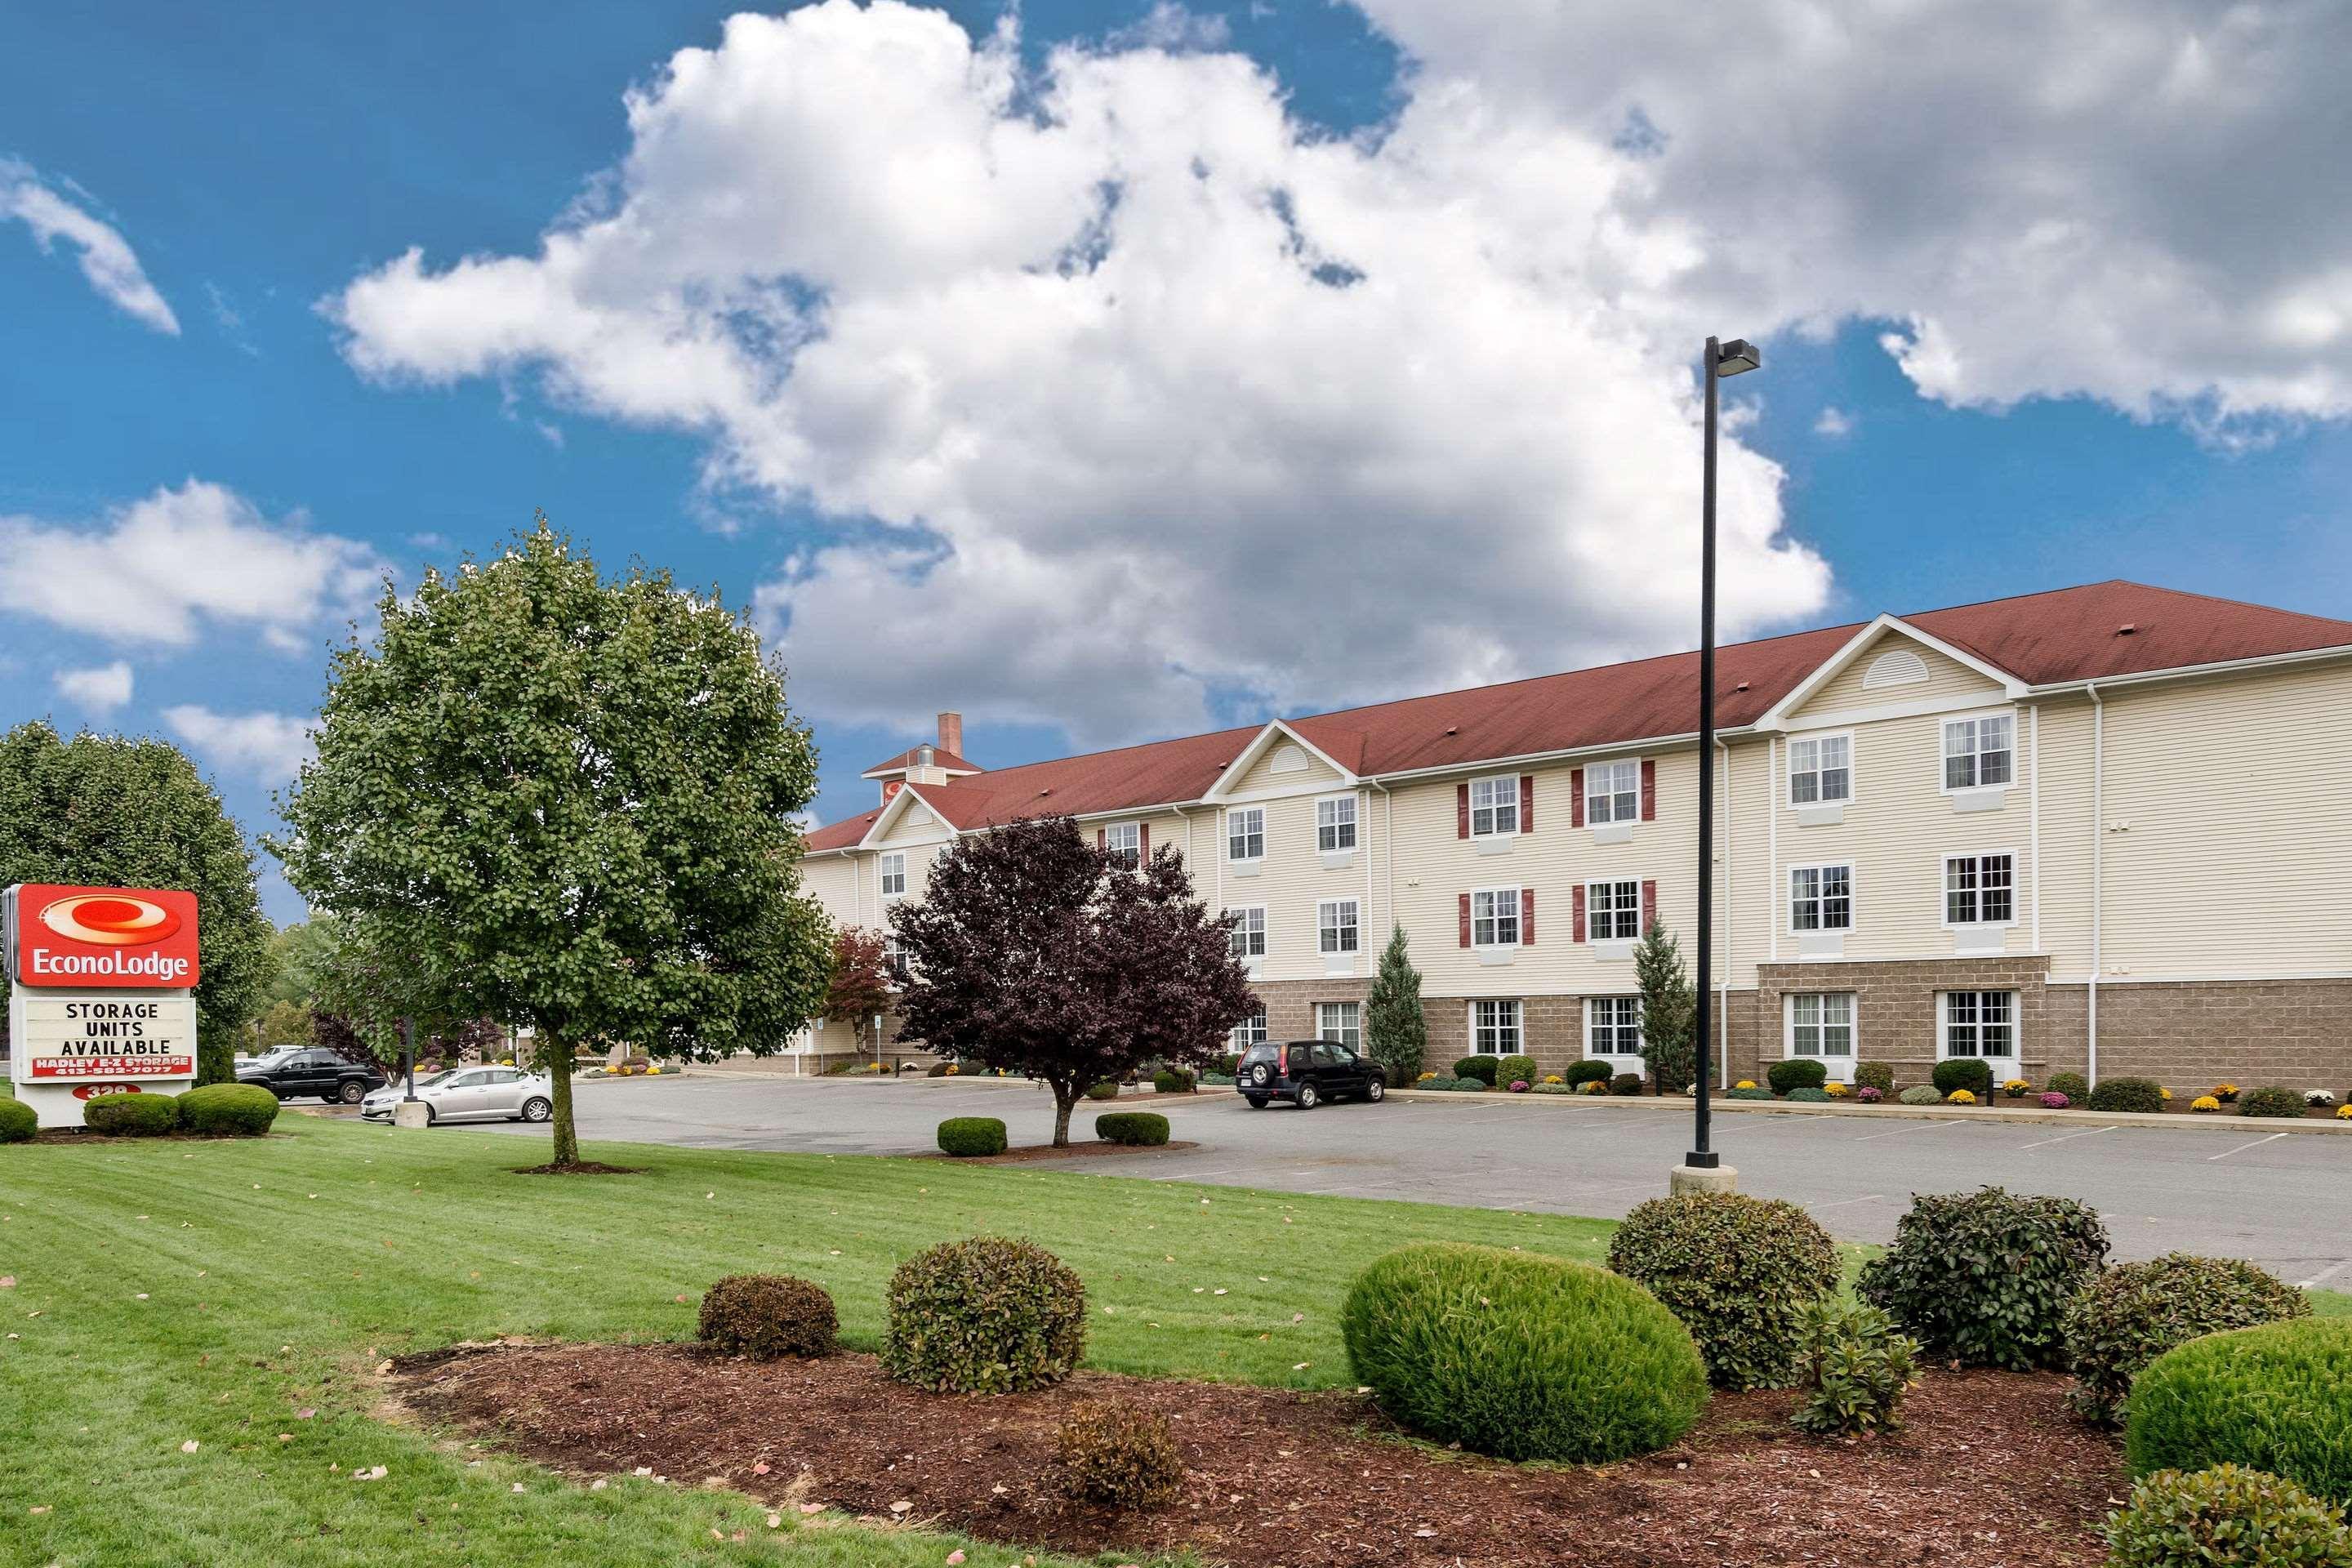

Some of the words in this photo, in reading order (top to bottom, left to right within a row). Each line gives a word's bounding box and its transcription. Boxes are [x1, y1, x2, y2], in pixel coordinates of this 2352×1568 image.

[33, 948, 189, 980] EconoLodge
[66, 1003, 158, 1018] STORAGE
[87, 1022, 143, 1036] UNITS
[61, 1040, 170, 1056] AVAILABLE
[37, 1058, 96, 1067] HADLEY
[99, 1058, 122, 1067] E-Z
[125, 1057, 189, 1067] STORAGE
